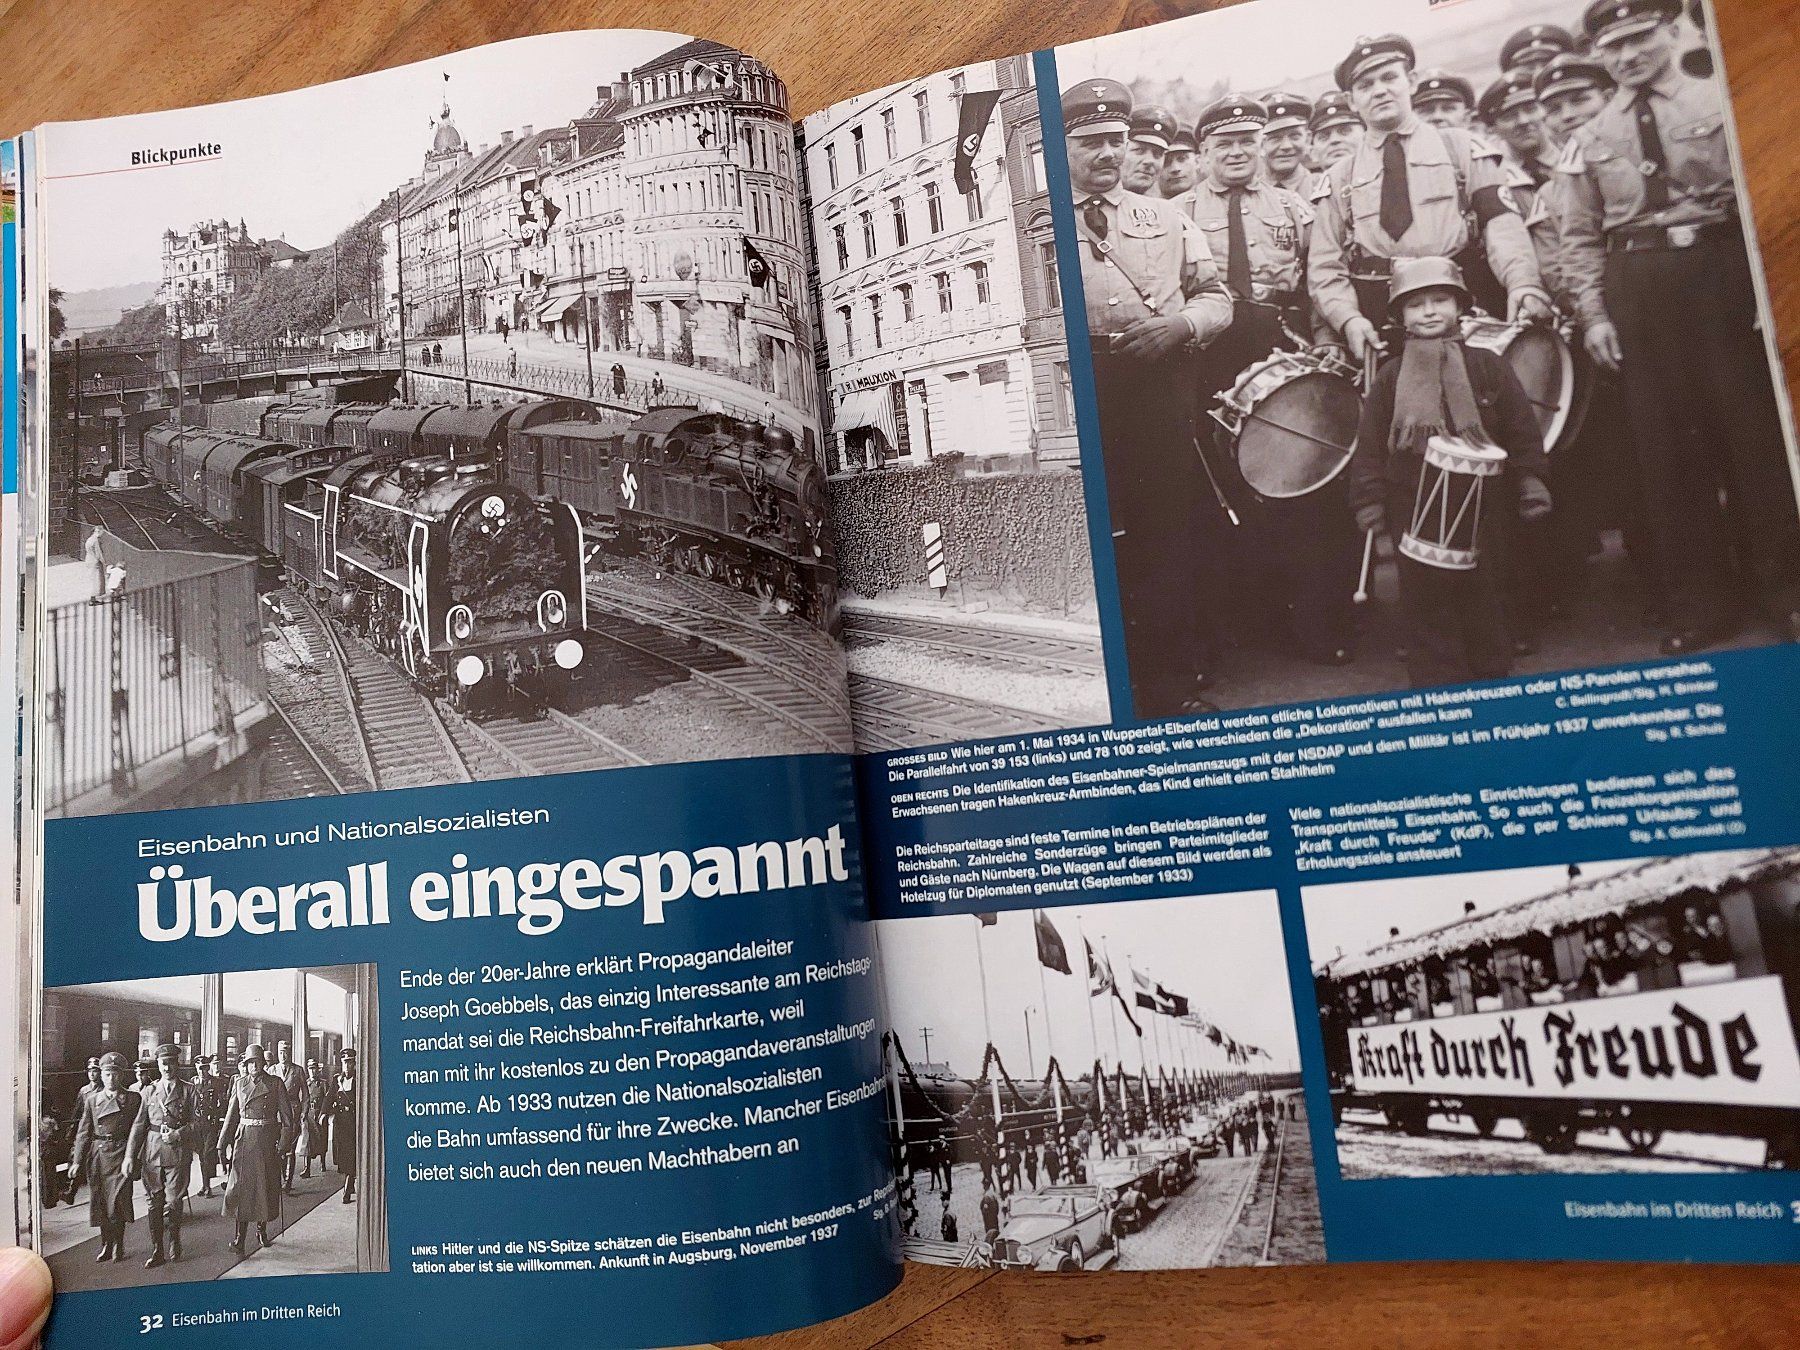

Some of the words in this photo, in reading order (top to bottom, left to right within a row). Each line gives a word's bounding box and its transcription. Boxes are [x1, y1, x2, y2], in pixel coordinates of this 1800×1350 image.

[132, 143, 220, 165] Blickpunkte
[887, 754, 926, 767] GROSSES
[928, 751, 948, 762] BILD
[950, 747, 972, 759] Wie
[973, 744, 995, 756] hier
[997, 743, 1017, 753] am
[1019, 739, 1030, 750] 1.
[1032, 736, 1054, 749] Mai
[1056, 733, 1086, 746] 1934
[1087, 732, 1100, 743] in
[1101, 718, 1220, 741] Wuppertal-Elberfeld
[1221, 714, 1269, 728] werden
[1271, 709, 1314, 723] etliche
[1315, 700, 1399, 718] Lokomotiven
[888, 771, 905, 781] Die
[906, 762, 968, 779] Parallelfahrt
[968, 762, 990, 772] von
[991, 758, 1006, 769] 39
[1008, 755, 1030, 767] 153
[1031, 751, 1068, 766] (links)
[1069, 748, 1093, 761] und
[1093, 746, 1111, 758] 78
[1112, 744, 1135, 756] 100
[1136, 740, 1169, 754] zeigt,
[1171, 738, 1194, 750] wie
[1195, 730, 1271, 747] verschieden
[890, 793, 914, 803] OBEN
[914, 789, 950, 800] RECHTS
[952, 785, 972, 796] Die
[973, 777, 1046, 794] Identifikation
[1047, 775, 1070, 786] des
[1071, 758, 1248, 784] Eisenbahner-Spielmannszugs
[892, 803, 959, 818] Erwachsenen
[960, 799, 996, 811] tragen
[997, 784, 1136, 807] Hakenkreuz-Armbinden,
[1137, 781, 1161, 793] das
[1162, 777, 1192, 790] Kind
[138, 832, 267, 857] Eisenbahn
[275, 825, 320, 846] und
[328, 809, 550, 841] Nationalsozialisten
[895, 846, 913, 857] Die
[913, 838, 1004, 855] Reichsparteitage
[1004, 834, 1030, 847] sind
[1030, 832, 1061, 844] feste
[1061, 827, 1111, 841] Termine
[1111, 826, 1124, 837] in
[1124, 824, 1149, 836] den
[1149, 816, 1244, 834] Betriebsplänen
[1288, 807, 1322, 820] Viele
[1290, 817, 1399, 837] Transportmittels
[897, 857, 961, 872] Reichsbahn.
[967, 851, 1028, 866] Zahlreiche
[1034, 844, 1107, 860] Sonderzüge
[1114, 841, 1162, 853] bringen
[899, 875, 919, 887] und
[919, 873, 951, 886] Gäste
[952, 870, 980, 883] nach
[981, 867, 1039, 880] Nürnberg.
[1040, 864, 1062, 876] Die
[1062, 862, 1105, 875] Wagen
[1106, 857, 1127, 870] auf
[137, 861, 390, 941] Überall
[409, 824, 848, 935] eingespannt
[900, 890, 947, 903] Hotelzug
[947, 888, 964, 899] für
[966, 883, 1032, 899] Diplomaten
[1033, 878, 1080, 895] genutzt
[1081, 873, 1154, 890] (September
[1157, 868, 1194, 882] 1933)
[400, 969, 443, 987] Ende
[447, 967, 476, 985] der
[481, 961, 571, 982] 20er-Jahre
[576, 956, 634, 976] erklärt
[638, 939, 794, 973] Propagandaleiter
[401, 1000, 460, 1022] Joseph
[464, 994, 554, 1016] Goebbels,
[559, 992, 593, 1010] das
[597, 986, 651, 1008] einzig
[656, 976, 770, 1002] Interessante
[774, 972, 801, 988] am
[805, 956, 873, 984] Reichstags-
[403, 1032, 464, 1051] mandat
[468, 1030, 493, 1048] sei
[498, 1028, 524, 1046] die
[529, 1010, 764, 1044] Reichsbahn-Freifahrkarte,
[769, 999, 805, 1021] weil
[1358, 1028, 1425, 1085] Kraft
[1430, 1016, 1535, 1088] durch
[1543, 1000, 1761, 1087] Freude
[404, 1070, 439, 1083] man
[444, 1064, 470, 1081] mit
[474, 1063, 496, 1080] ihr
[500, 1058, 585, 1079] kostenlos
[589, 1060, 610, 1074] zu
[615, 1054, 650, 1072] den
[655, 1018, 876, 1070] Propagandaveranstaltungen
[405, 1099, 471, 1116] komme.
[476, 1095, 501, 1113] Ab
[507, 1093, 553, 1111] 1933
[557, 1092, 617, 1113] nutzen
[622, 1086, 651, 1105] die
[655, 1067, 823, 1102] Nationalsozialisten
[406, 1131, 432, 1148] die
[437, 1129, 481, 1147] Bahn
[486, 1124, 582, 1145] umfassend
[586, 1123, 612, 1141] für
[617, 1120, 652, 1139] ihre
[657, 1112, 739, 1135] Zwecke.
[744, 1099, 823, 1125] Mancher
[408, 1163, 455, 1181] bietet
[459, 1161, 494, 1179] sich
[499, 1159, 542, 1178] auch
[547, 1158, 581, 1176] den
[586, 1158, 643, 1174] neuen
[648, 1143, 772, 1170] Machthabern
[777, 1138, 800, 1154] an
[411, 1246, 438, 1255] LINKS
[441, 1243, 474, 1254] Hitler
[477, 1239, 501, 1254] und
[504, 1242, 524, 1253] die
[527, 1240, 590, 1254] NS-Spitze
[594, 1237, 653, 1250] schätzen
[656, 1234, 678, 1246] die
[681, 1226, 752, 1244] Eisenbahn
[755, 1218, 789, 1234] nicht
[791, 1204, 856, 1228] besonders,
[857, 1195, 873, 1209] zur
[1564, 1201, 1648, 1218] Eisenbahn
[1650, 1203, 1672, 1217] im
[1674, 1201, 1733, 1218] Dritten
[1735, 1202, 1783, 1218] Reich
[411, 1261, 446, 1273] tation
[448, 1261, 476, 1272] aber
[478, 1260, 494, 1272] ist
[495, 1260, 514, 1272] sie
[516, 1259, 596, 1271] willkommen.
[598, 1254, 651, 1269] Ankunft
[652, 1253, 665, 1265] in
[667, 1248, 737, 1264] Augsburg,
[739, 1235, 807, 1255] November
[810, 1224, 839, 1241] 1937
[140, 1315, 163, 1333] 32
[172, 1309, 239, 1326] Eisenbahn
[242, 1308, 258, 1321] im
[261, 1306, 304, 1319] Dritten
[307, 1303, 341, 1317] Reich
